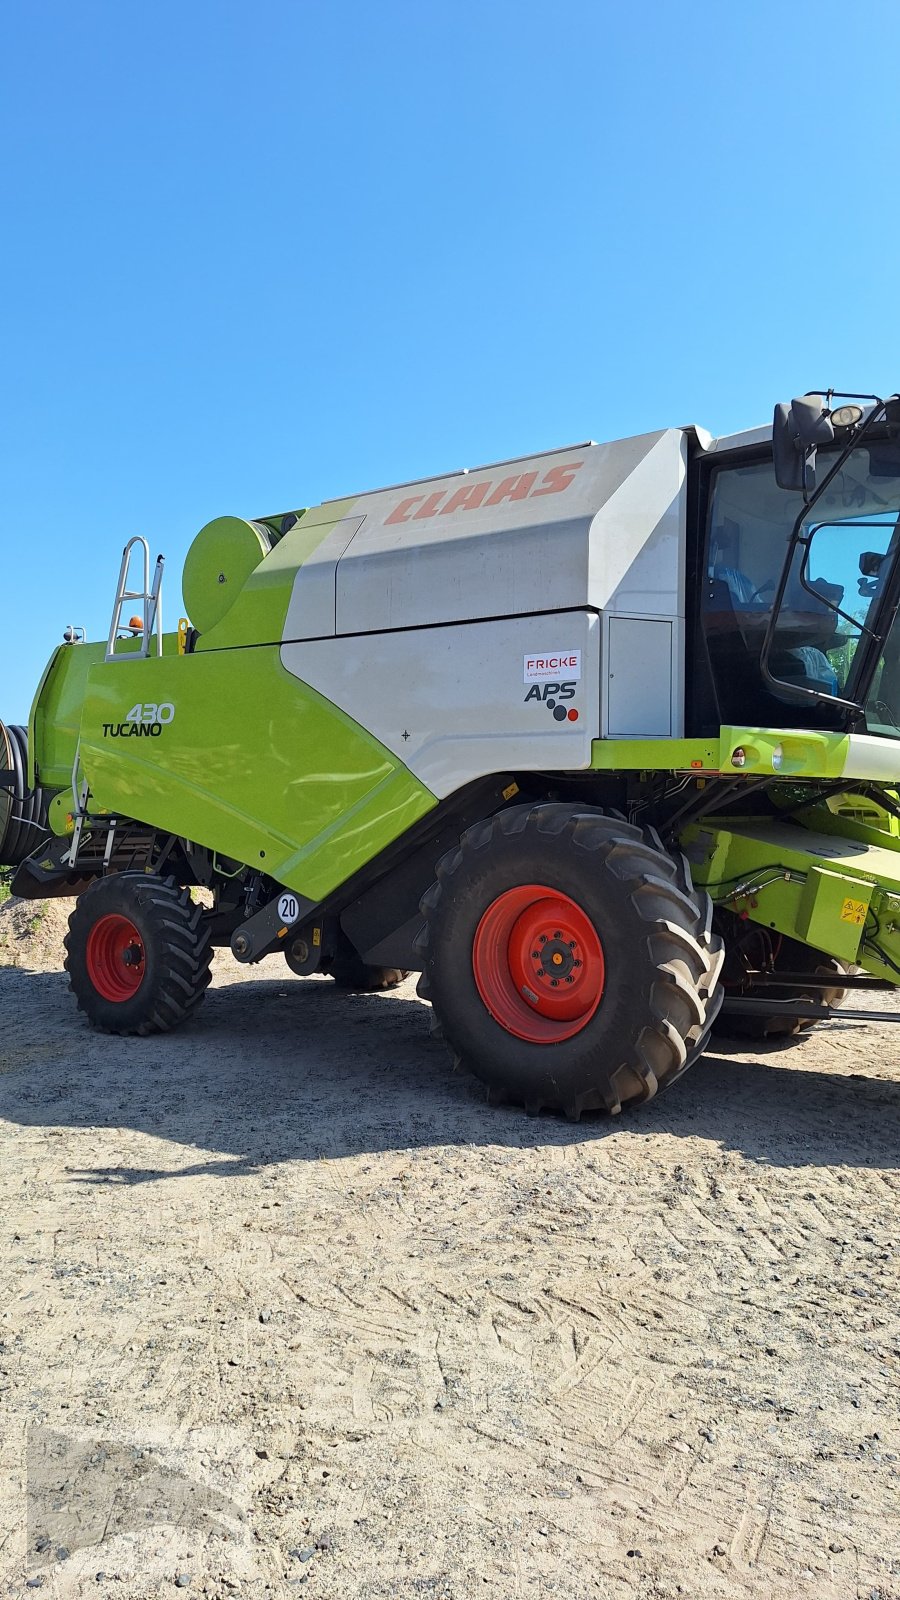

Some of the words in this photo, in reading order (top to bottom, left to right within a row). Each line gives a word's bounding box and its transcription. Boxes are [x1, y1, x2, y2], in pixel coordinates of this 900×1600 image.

[384, 462, 584, 525] CLAAS
[527, 656, 577, 670] FRICKE
[524, 682, 576, 702] APS
[126, 702, 175, 725] 430
[102, 722, 162, 737] TUCANO
[281, 898, 296, 918] 20
